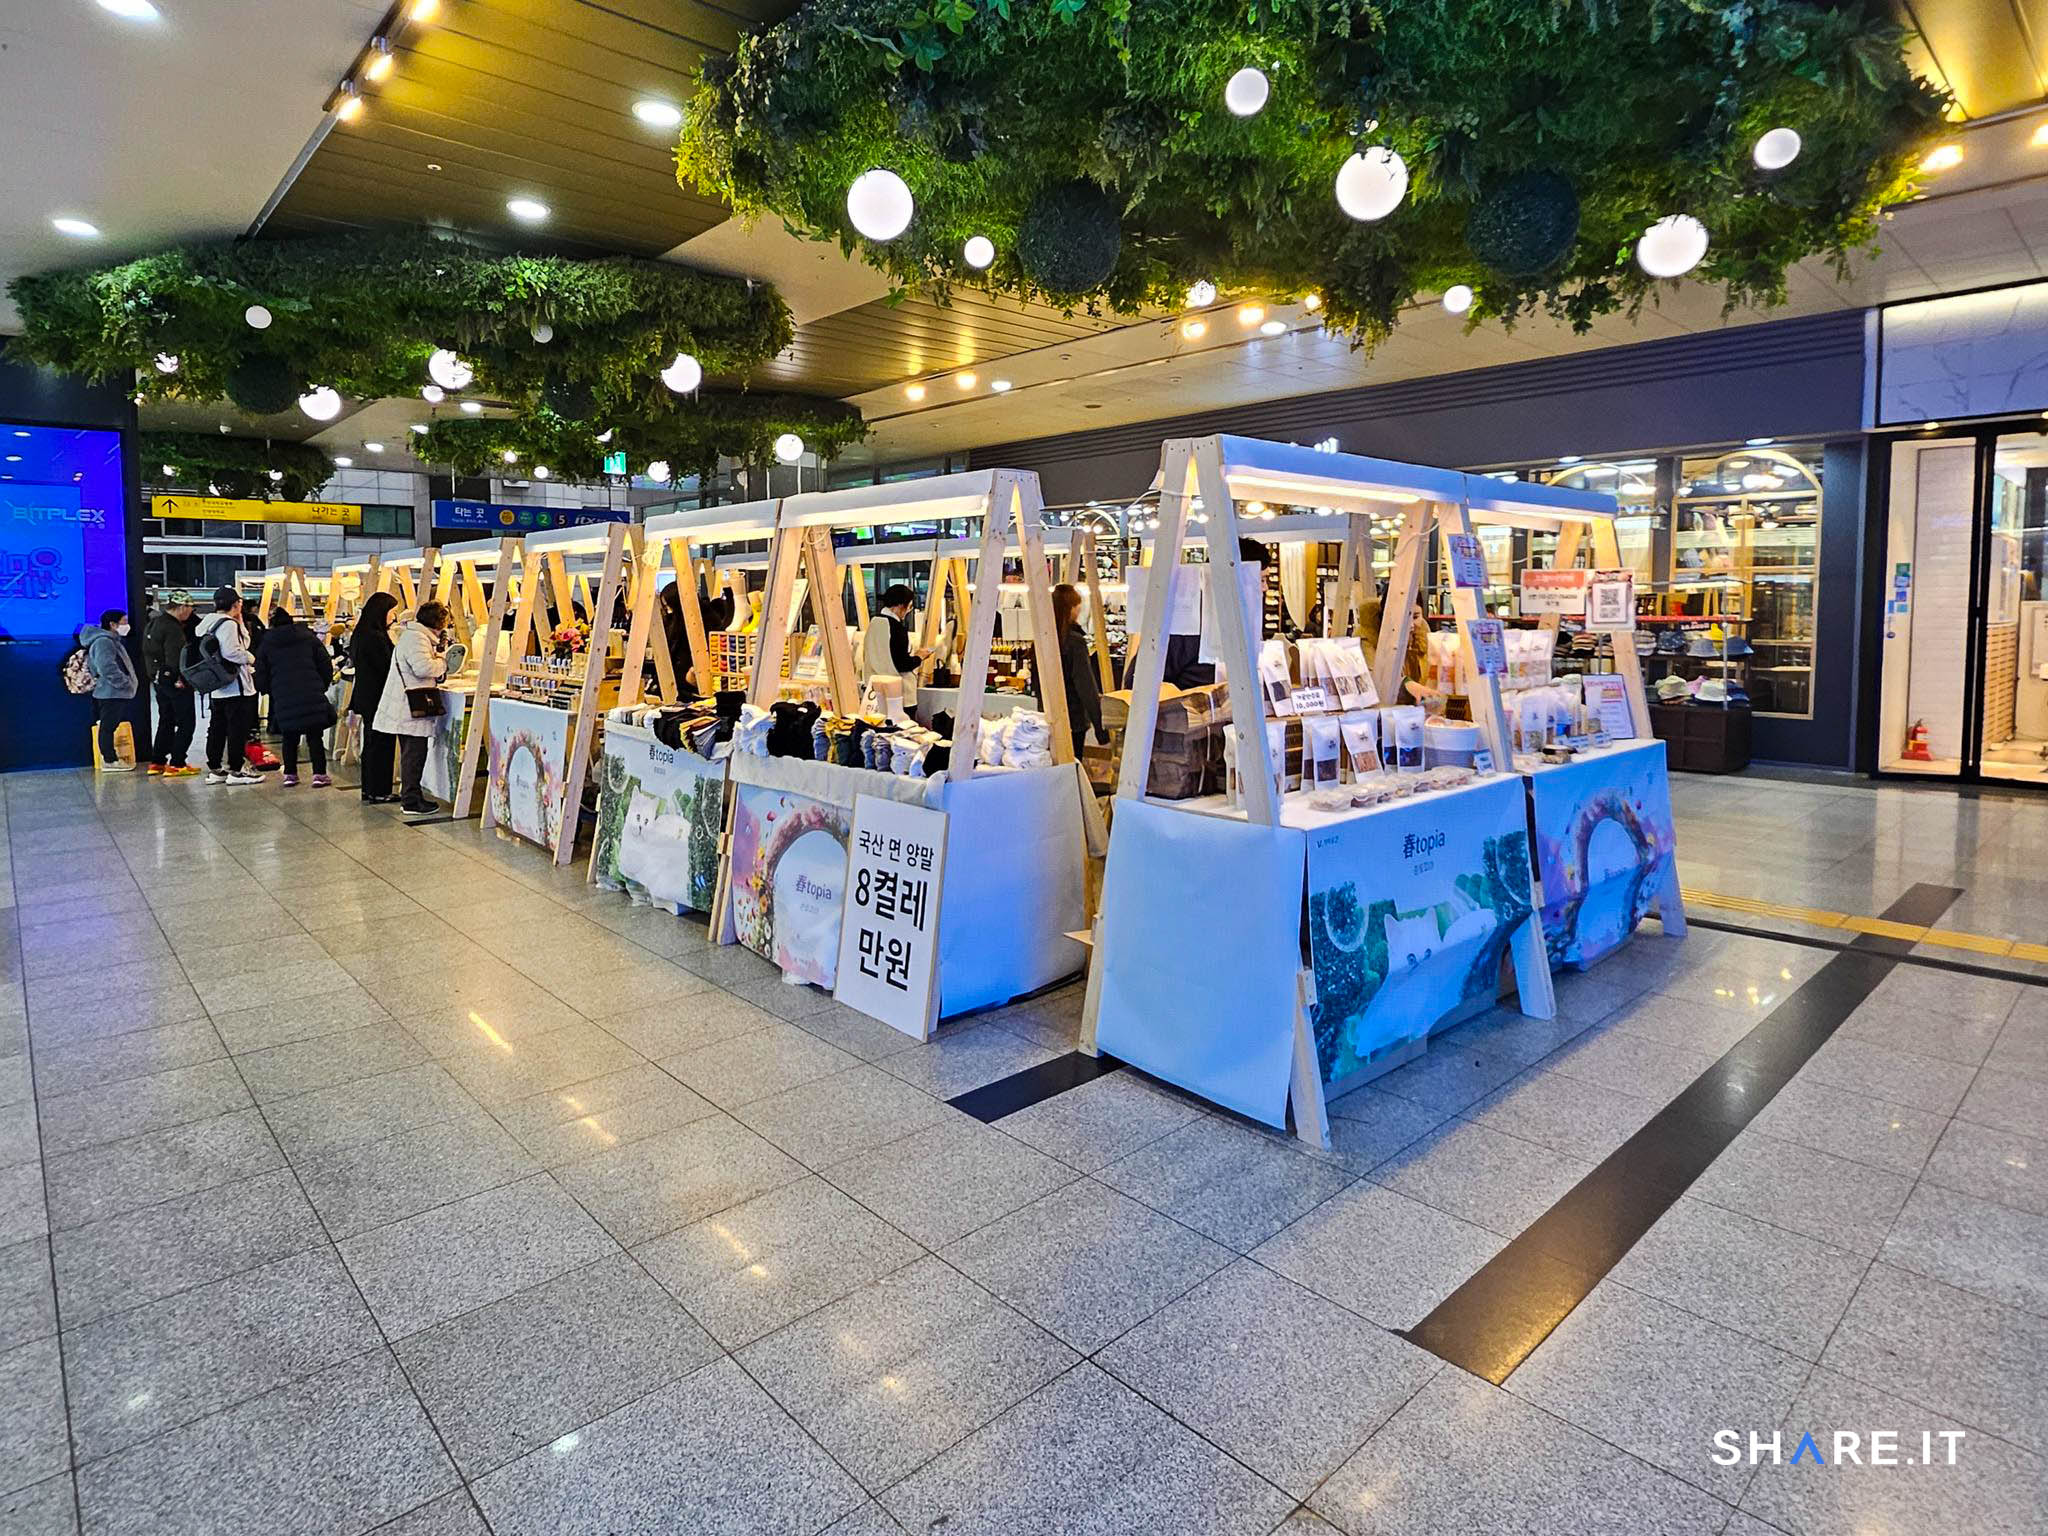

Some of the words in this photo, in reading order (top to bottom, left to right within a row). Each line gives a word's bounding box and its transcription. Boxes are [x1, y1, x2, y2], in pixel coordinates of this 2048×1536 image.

[12, 504, 105, 523] BITPLEX
[311, 506, 338, 516] 나가는
[342, 507, 350, 517] 곳
[454, 507, 472, 517] 타는
[476, 508, 485, 518] 곳
[859, 830, 884, 857] 국산
[888, 839, 901, 862] 면
[906, 843, 935, 872] 양말
[1403, 829, 1446, 859] 春topia
[796, 874, 832, 900] 春topia
[855, 868, 928, 931] 8켤레
[858, 928, 912, 992] 만원
